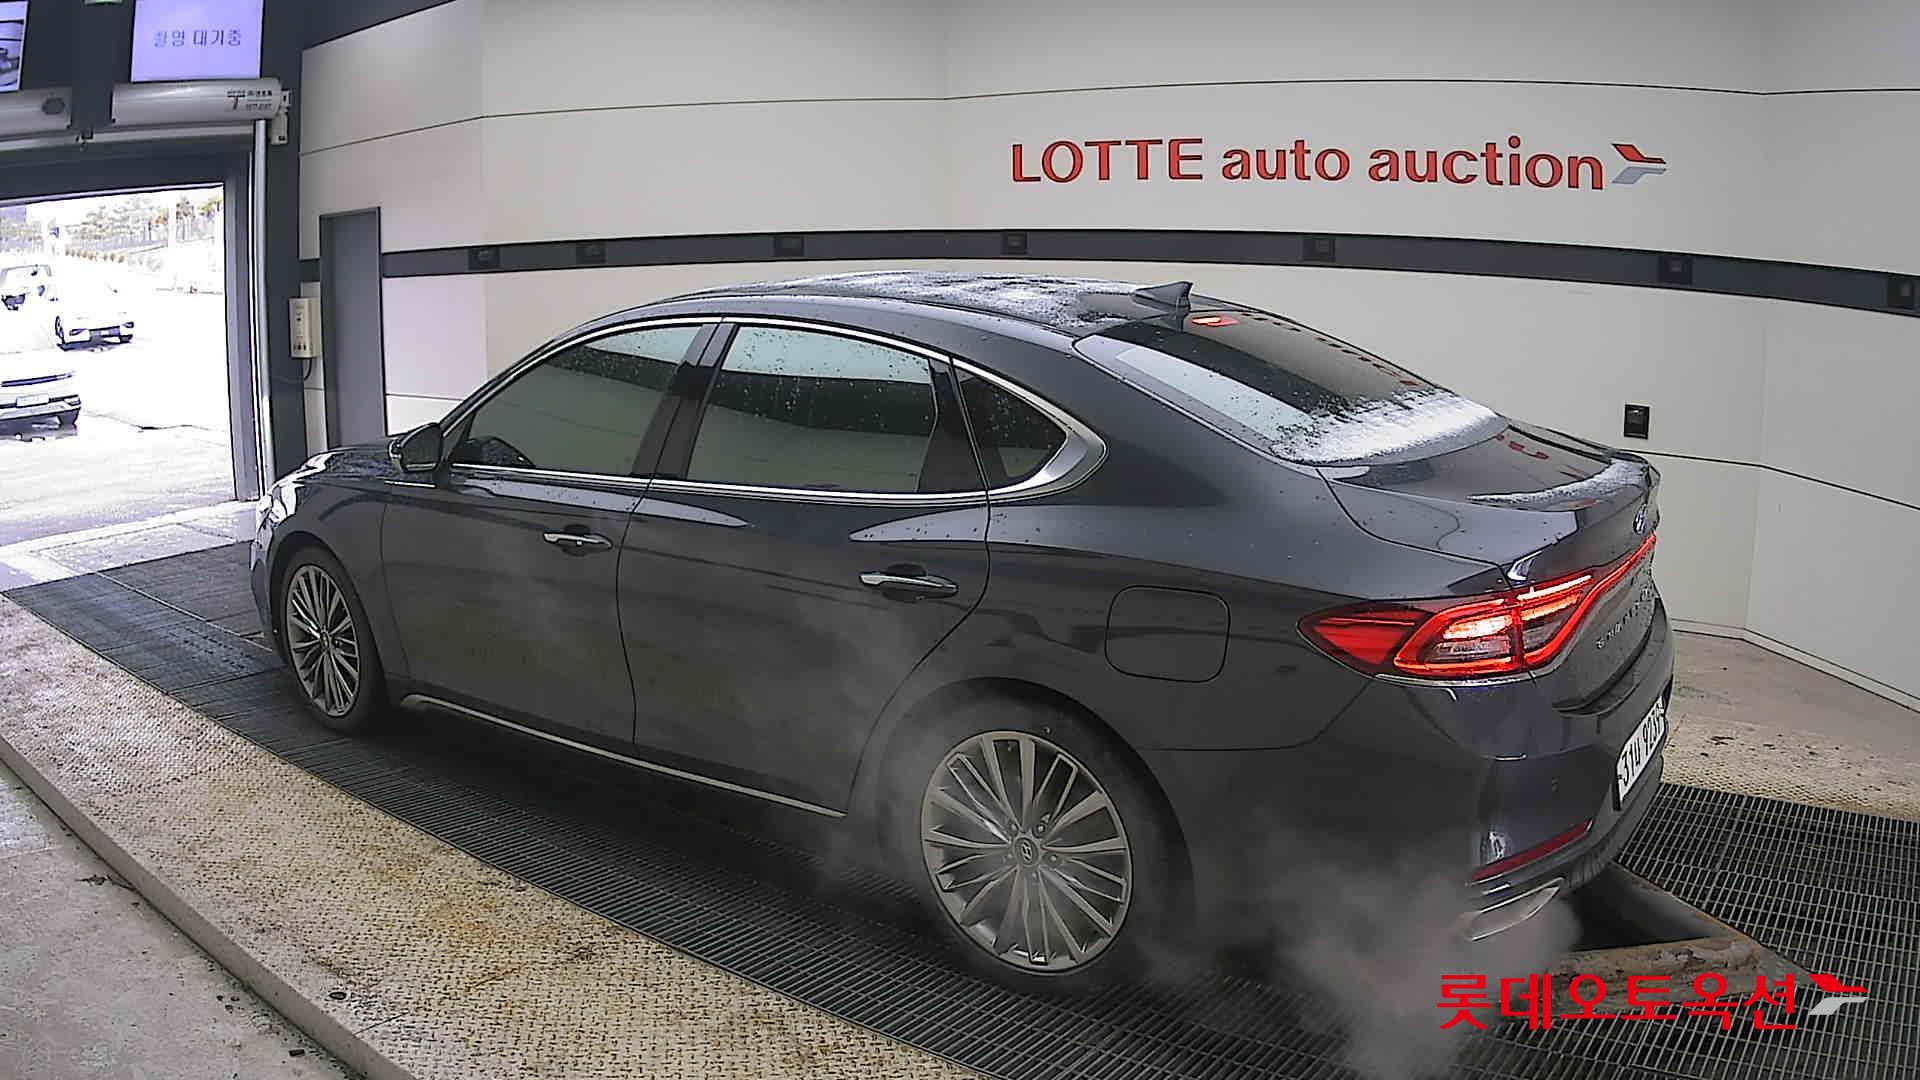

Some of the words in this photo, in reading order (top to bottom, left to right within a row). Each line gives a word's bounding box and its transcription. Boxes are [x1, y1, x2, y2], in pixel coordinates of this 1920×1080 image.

[192, 28, 243, 48] 대기중
[1012, 138, 1203, 183] LOTTE
[1222, 139, 1351, 183] auto
[1368, 135, 1605, 191] auction
